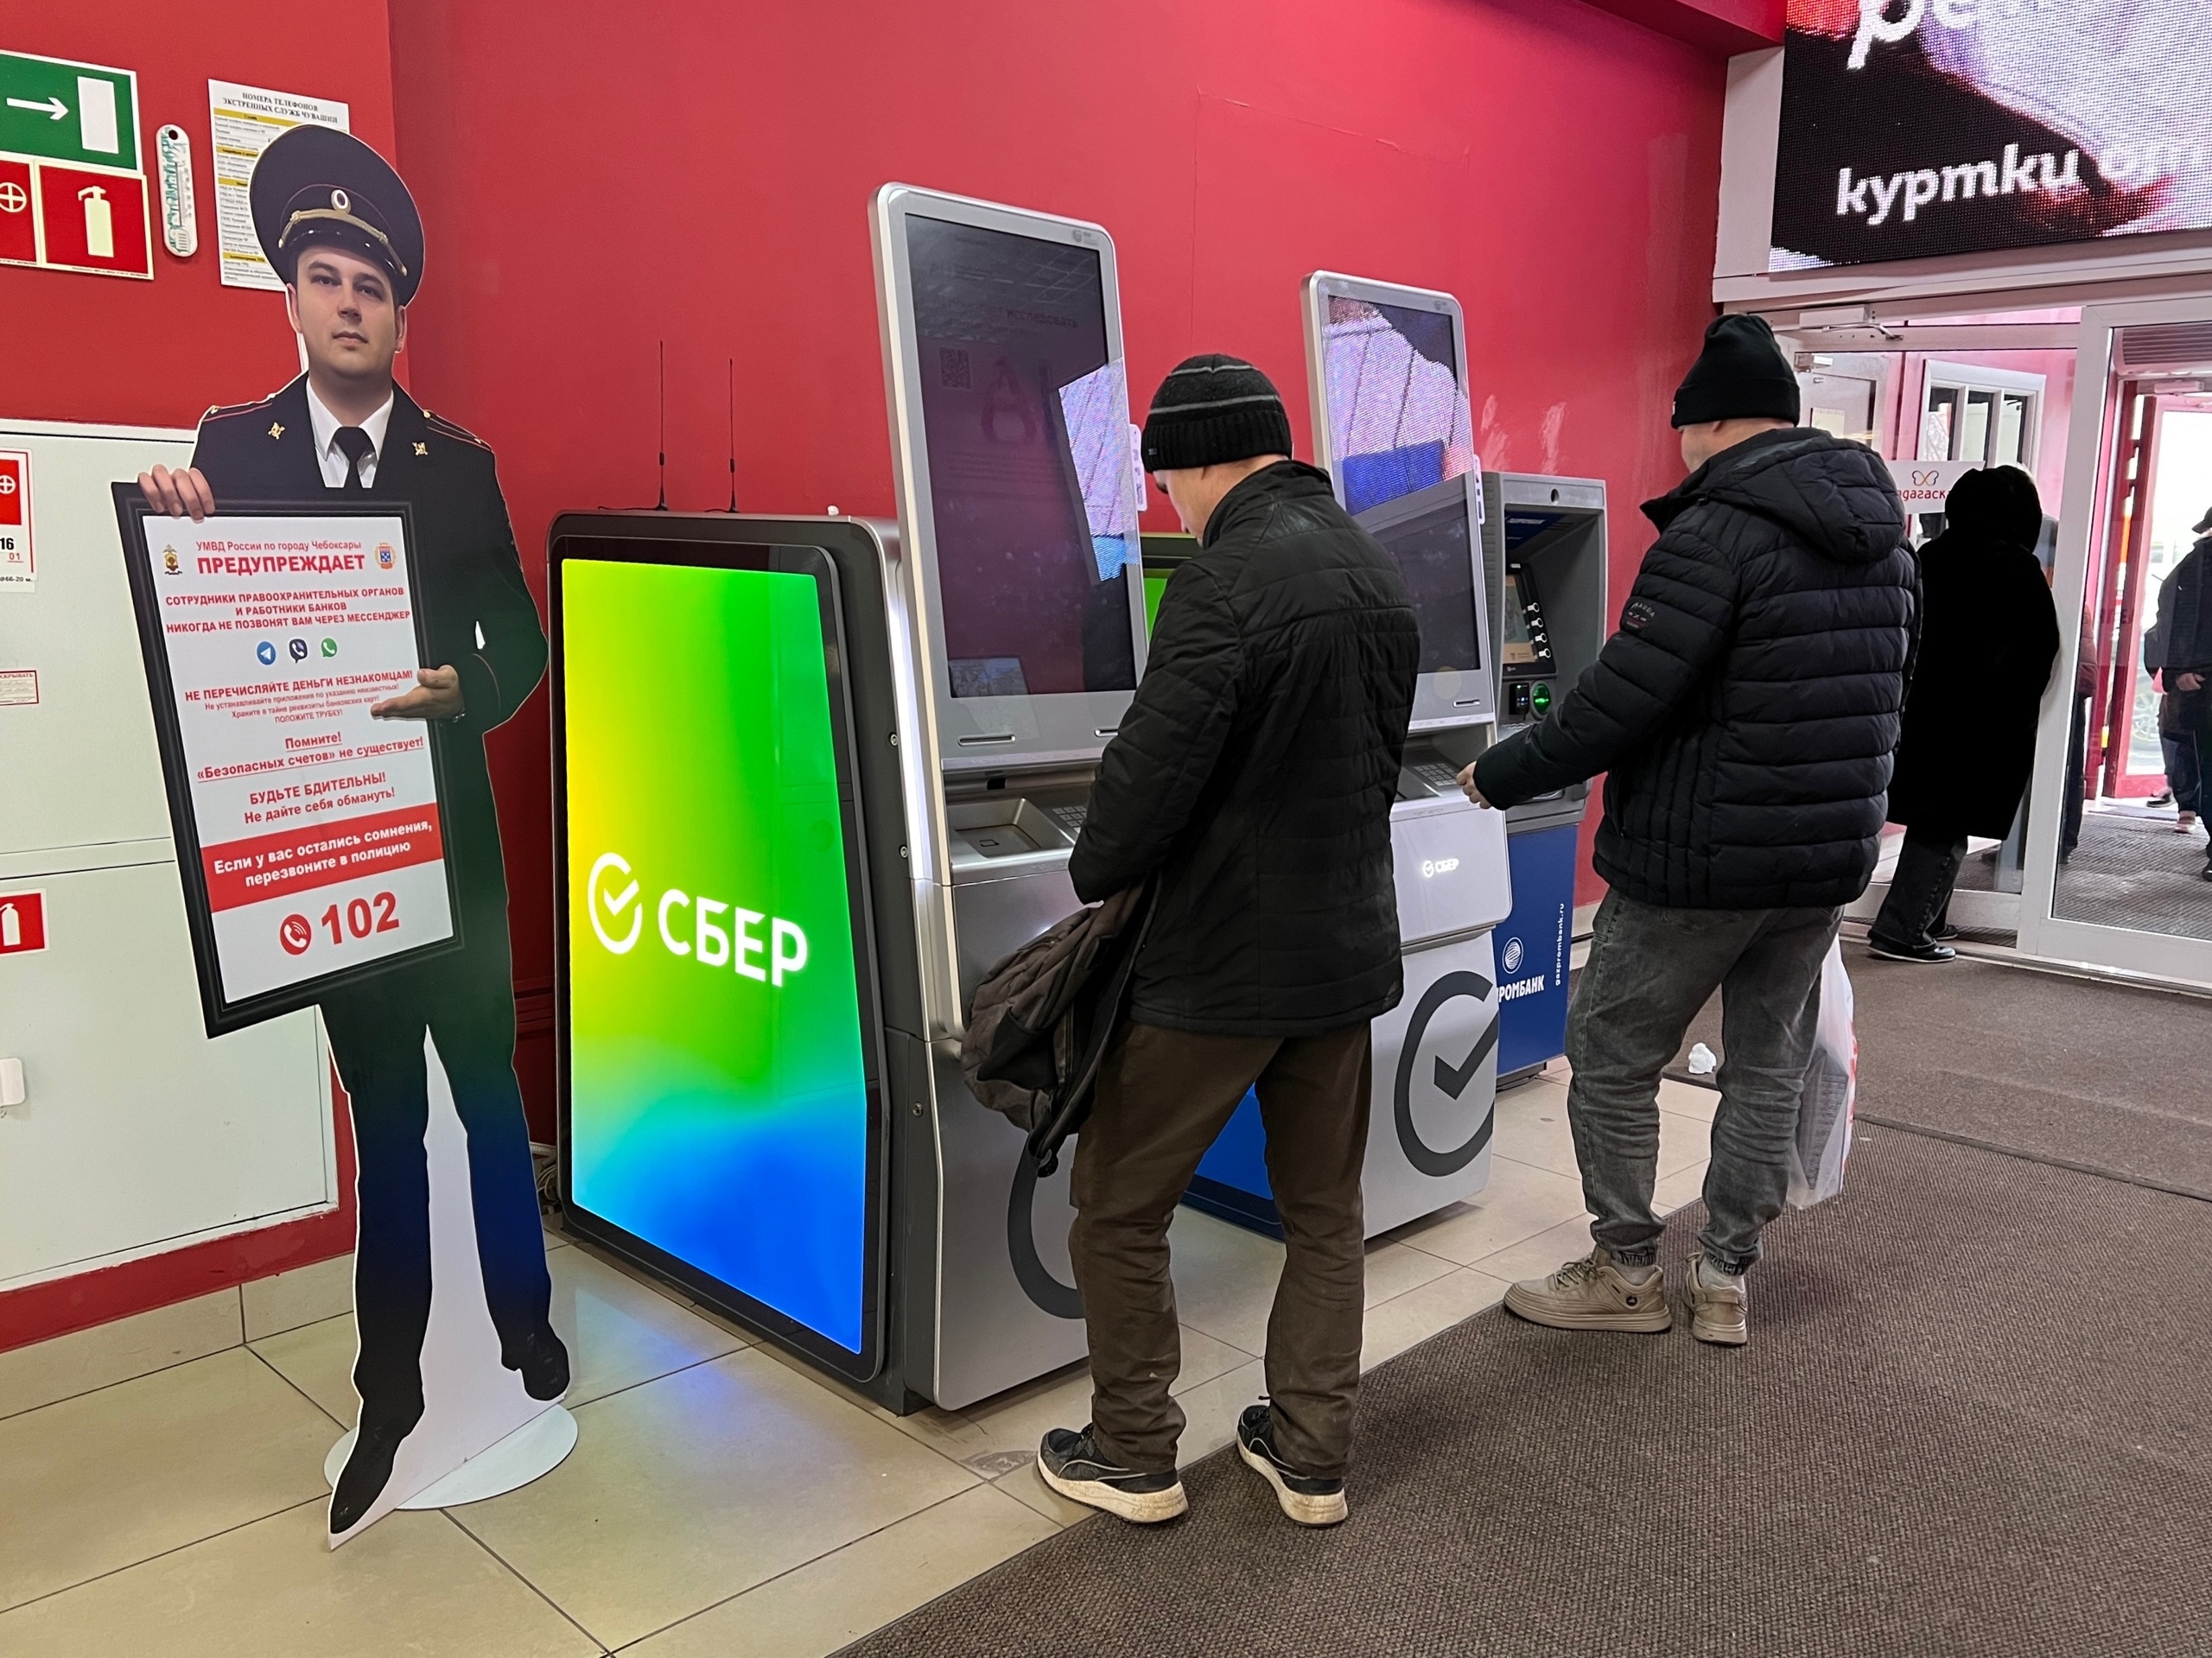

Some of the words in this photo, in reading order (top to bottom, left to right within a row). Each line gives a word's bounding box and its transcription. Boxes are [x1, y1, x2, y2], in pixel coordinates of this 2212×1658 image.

[222, 97, 273, 112] ЭКСТРЕННЫХ
[274, 106, 301, 117] СЛУЖБ
[302, 111, 338, 124] ЧУВАШИИ
[242, 92, 272, 104] НОМЕРА
[274, 98, 319, 111] ТЕЛЕФОНОВ
[1835, 142, 2080, 226] куртки
[1897, 489, 1951, 501] дагаск
[196, 541, 225, 552] УМВД
[228, 541, 261, 551] России
[264, 543, 276, 551] по
[278, 543, 309, 553] городу
[312, 540, 362, 551] Чебоксары
[197, 555, 365, 575] ПРЕДУПРЕЖДАЕТ
[166, 594, 236, 607] СОТРУДНИКИ
[239, 589, 359, 603] ПРАВООХРАНИТЕЛЬНЫХ
[362, 587, 404, 598] ОРГАНОВ
[236, 607, 244, 616] И
[246, 605, 306, 616] РАБОТНИКИ
[308, 602, 347, 613] БАНКОВ
[166, 621, 217, 633] НИКОГДА
[219, 620, 232, 630] НЕ
[235, 618, 289, 630] ПОЗВОНЯТ
[292, 616, 313, 626] ВАМ
[315, 614, 345, 625] ЧЕРЕЗ
[347, 611, 410, 623] МЕССЕНДЖЕР
[185, 691, 200, 702] НЕ
[203, 682, 290, 700] ПЕРЕЧИСЛЯЙТЕ
[292, 677, 334, 692] ДЕНЬГИ
[336, 670, 413, 686] НЕЗНАКОМЦАМ!
[206, 702, 215, 711] Не
[217, 696, 272, 710] устанавливайте
[273, 692, 315, 705] приложения
[325, 689, 356, 699] указанию
[232, 709, 259, 719] Храните
[268, 705, 288, 715] тайне
[289, 702, 324, 713] реквизиты
[326, 697, 362, 708] банковских
[275, 713, 315, 724] ПОЛОЖИТЕ
[316, 709, 343, 720] ТРУБКУ!
[285, 732, 341, 749] Помните!
[197, 758, 284, 779] «Безопасных
[288, 752, 335, 765] счетов»
[340, 748, 353, 759] не
[357, 737, 423, 757] существует!
[250, 786, 301, 805] БУДЬТЕ
[304, 772, 386, 797] БДИТЕЛЬНЫ!
[245, 812, 261, 824] Не
[266, 804, 301, 820] дайте
[305, 799, 334, 812] себя
[337, 787, 395, 808] обмануть!
[213, 856, 252, 874] Если
[256, 854, 264, 868] у
[268, 847, 293, 862] вас
[297, 835, 361, 857] остались
[364, 820, 433, 842] сомнения,
[245, 854, 336, 887] перезвоните
[340, 854, 347, 864] в
[351, 842, 411, 863] полицию
[321, 891, 399, 945] 102
[658, 888, 808, 988] СБЕР
[1555, 903, 1565, 987] gazprombank.ru
[1497, 975, 1545, 1003] РОМБАНК
